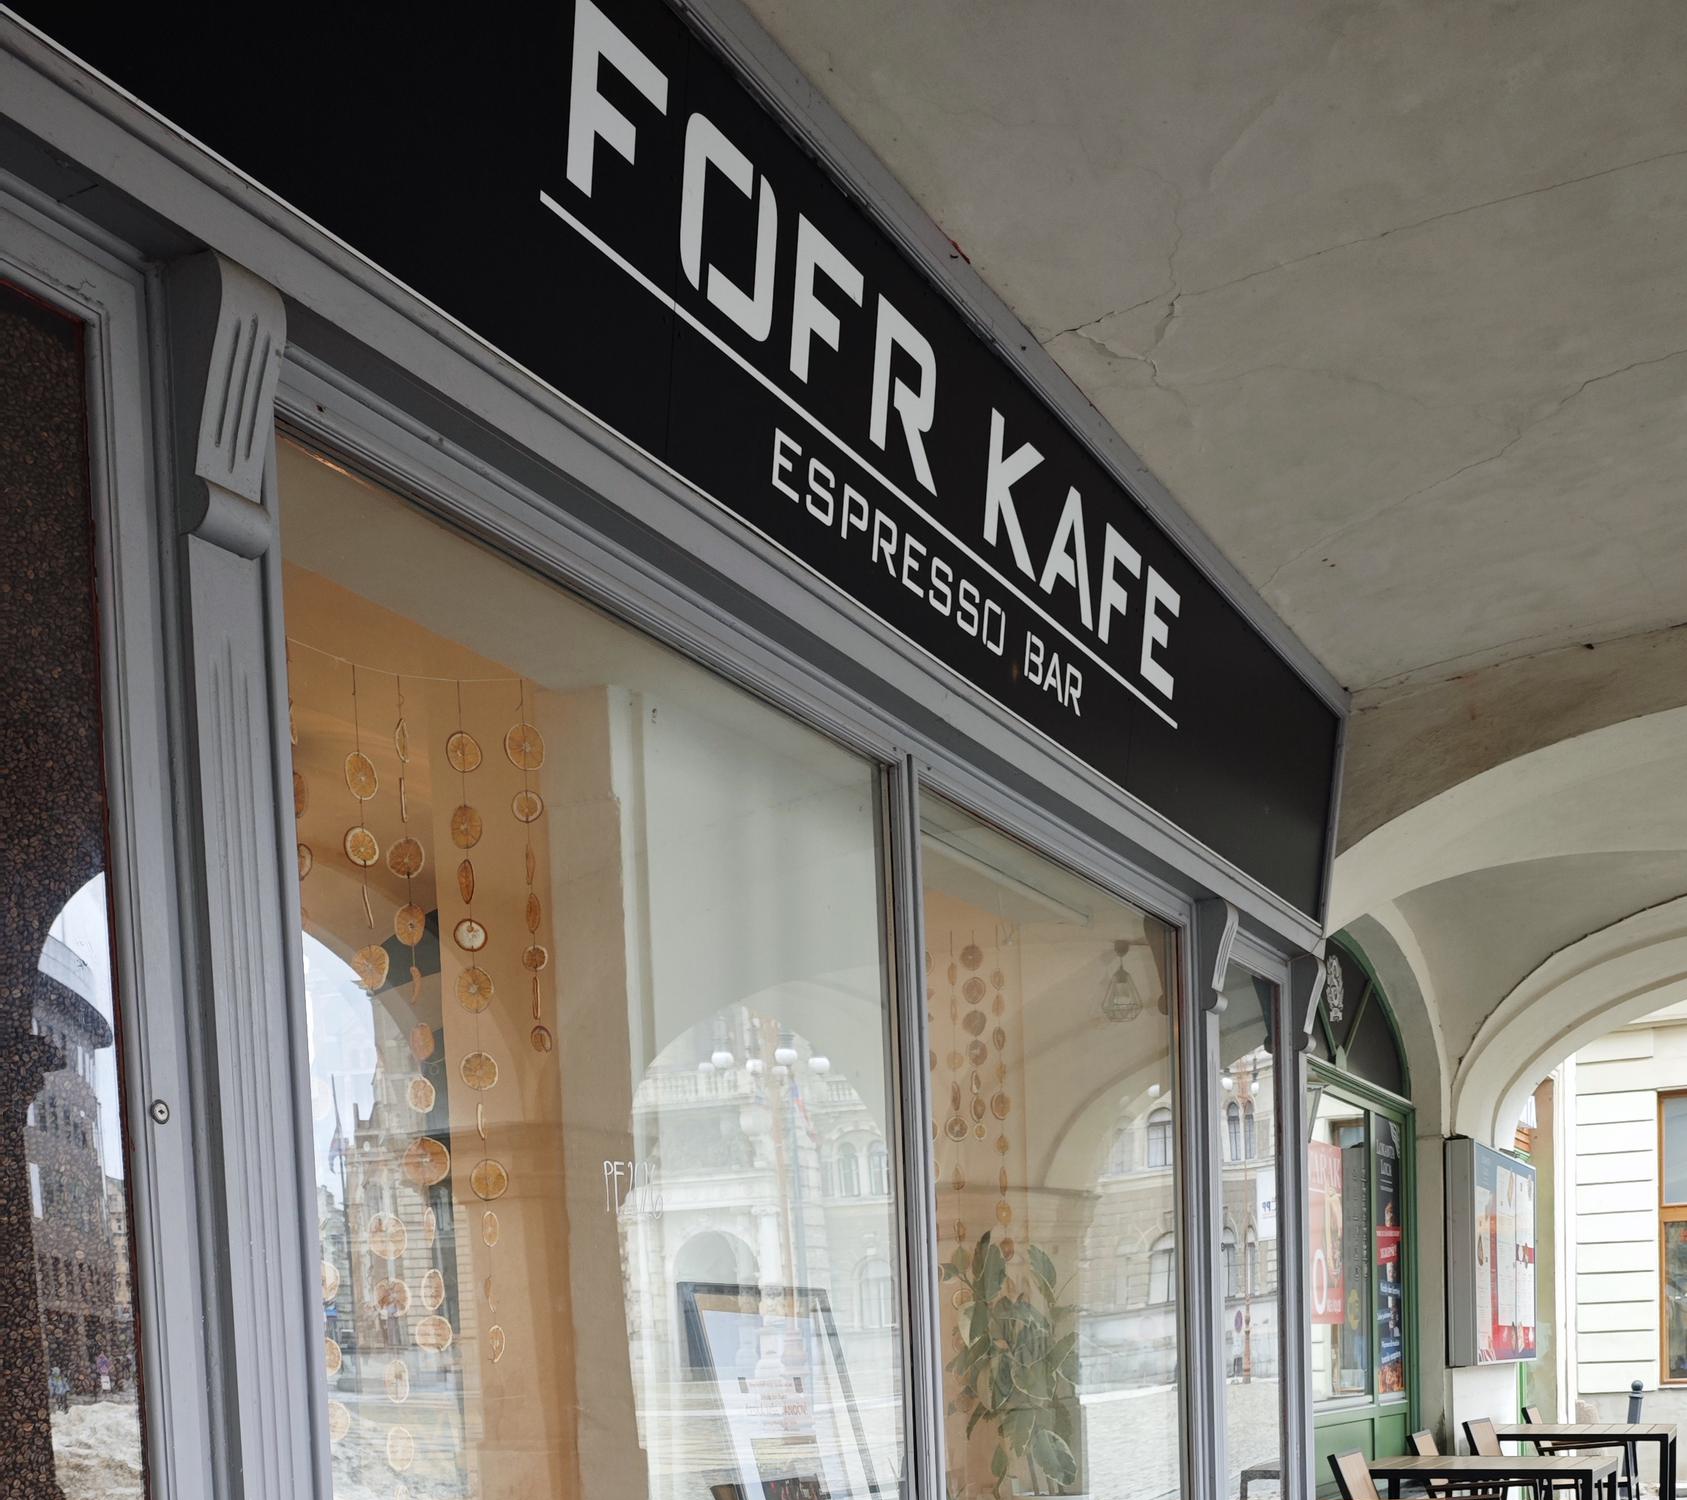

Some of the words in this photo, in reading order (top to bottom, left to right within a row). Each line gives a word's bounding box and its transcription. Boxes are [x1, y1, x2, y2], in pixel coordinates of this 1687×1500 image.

[566, 0, 938, 497] FOFR
[983, 407, 1181, 701] KAFE
[771, 427, 1006, 656] ESPRESSO
[1023, 630, 1083, 717] BAR
[603, 1160, 625, 1215] PF
